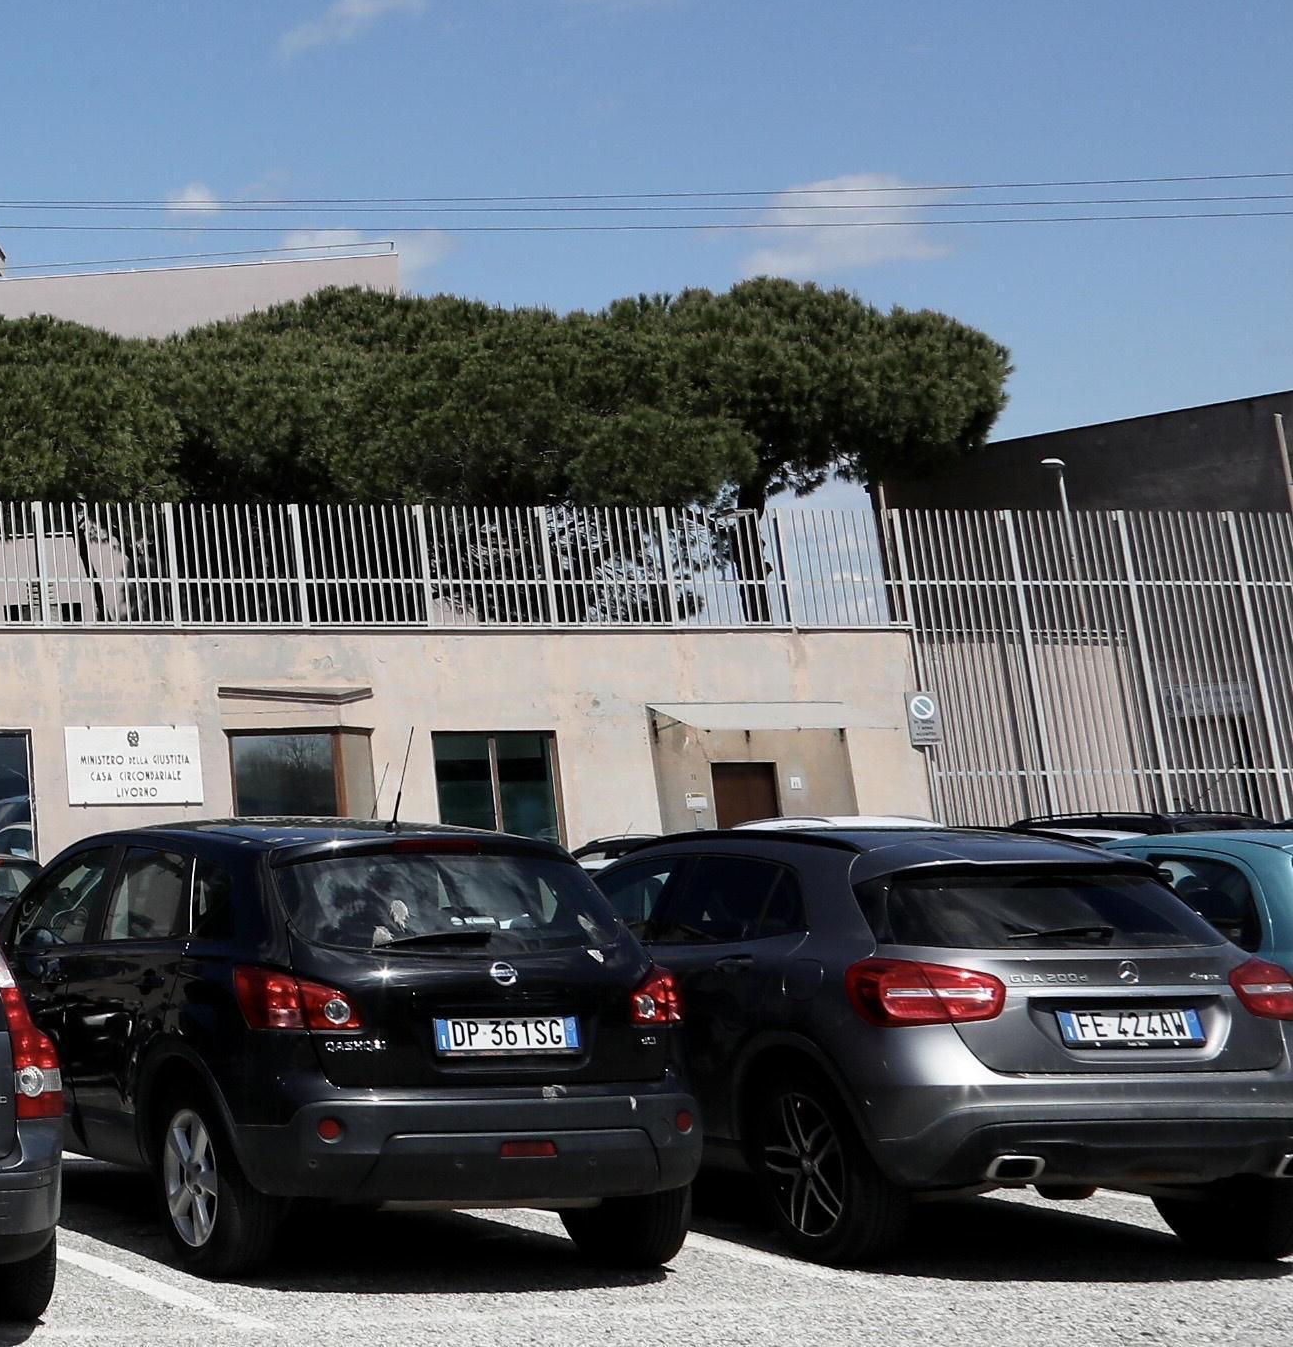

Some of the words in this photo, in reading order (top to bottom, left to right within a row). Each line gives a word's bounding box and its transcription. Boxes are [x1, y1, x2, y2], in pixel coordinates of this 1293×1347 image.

[80, 755, 124, 765] MINISTERO
[129, 756, 148, 765] DELLA
[152, 754, 190, 765] GIUSTIZIA
[90, 771, 112, 781] CASA
[119, 770, 181, 781] CIRCONDARIALE
[116, 787, 158, 797] LIVORNO
[1010, 973, 1044, 983] GLA
[1076, 1012, 1108, 1038] FE
[1117, 1011, 1187, 1038] 424AW
[451, 1020, 479, 1047] DP
[488, 1019, 562, 1046] 361SG
